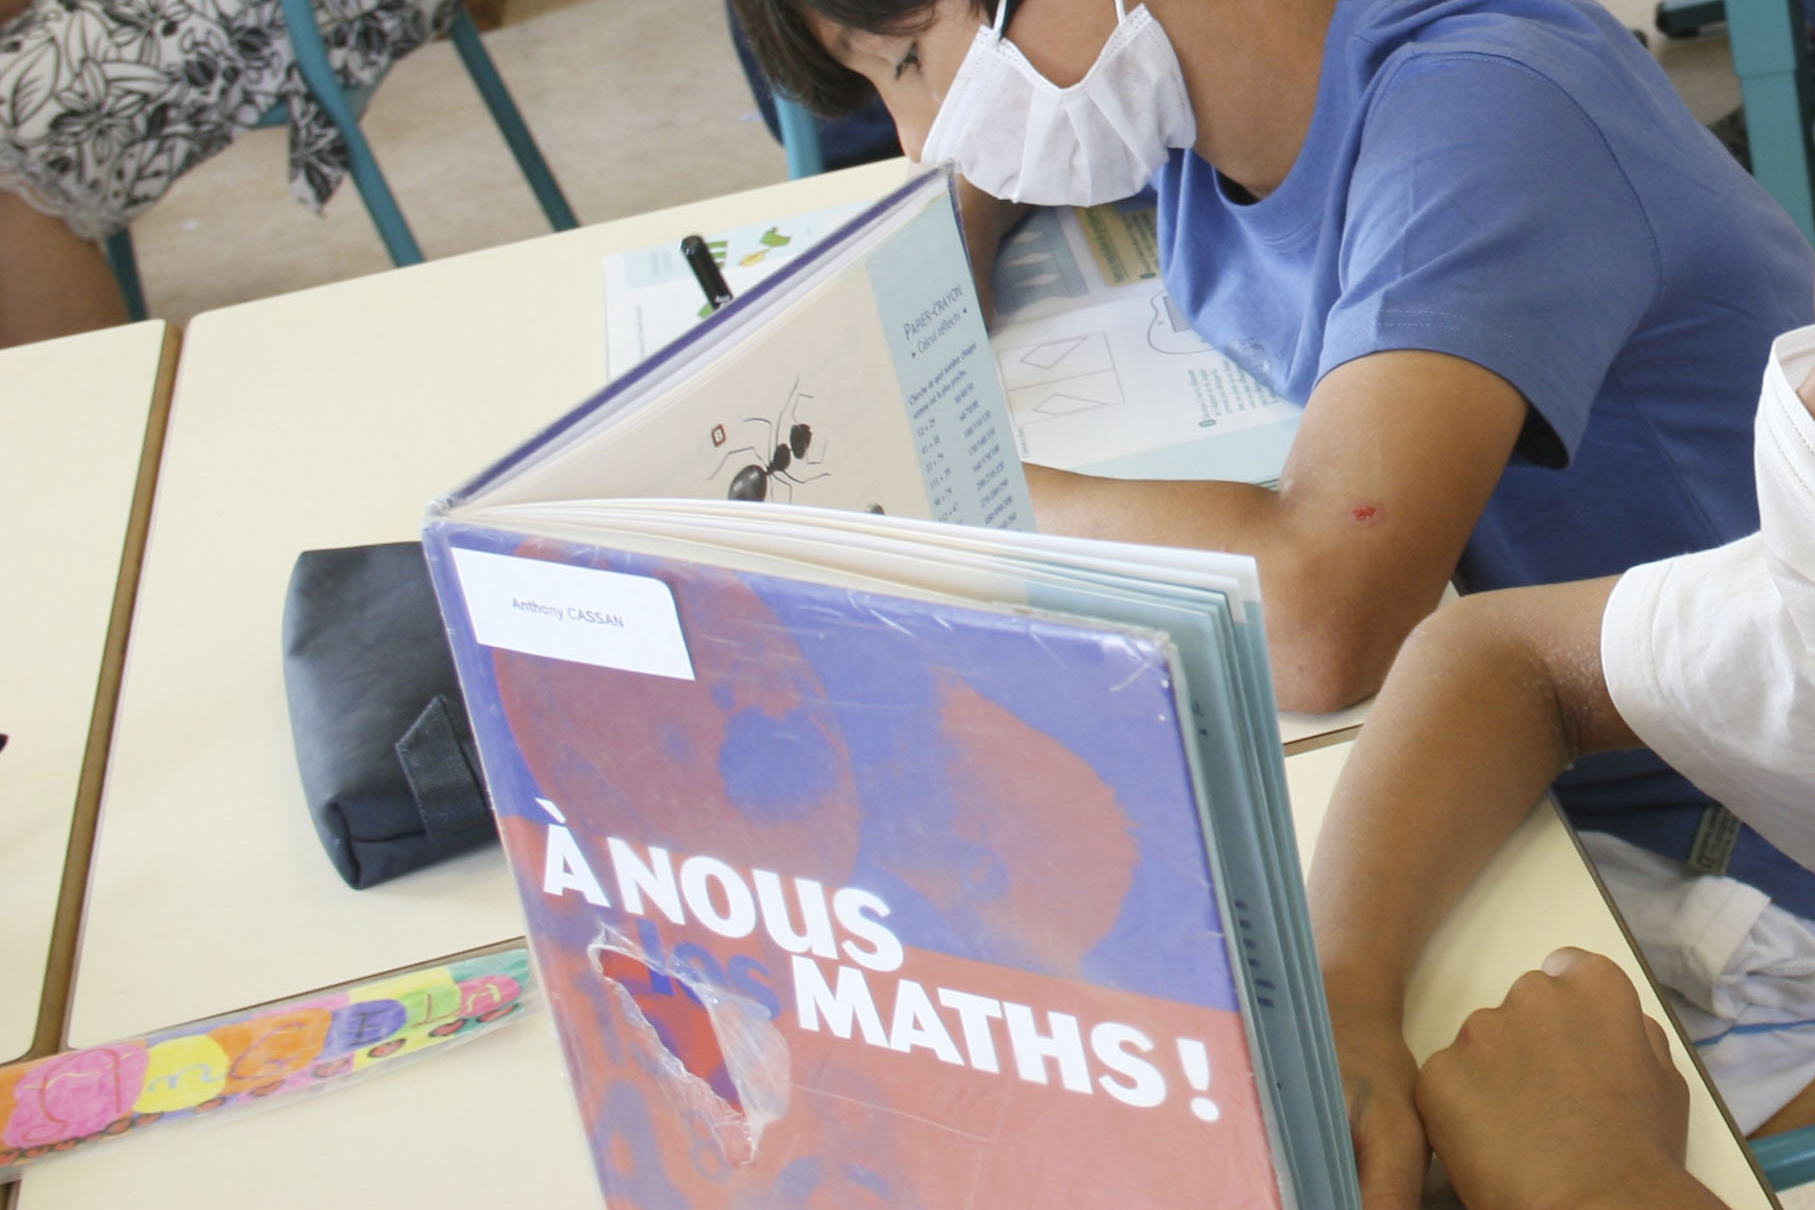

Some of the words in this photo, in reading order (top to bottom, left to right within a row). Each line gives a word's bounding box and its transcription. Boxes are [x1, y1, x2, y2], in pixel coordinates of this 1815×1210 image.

[512, 597, 563, 621] Anthony
[567, 606, 624, 628] CASSAN
[535, 797, 611, 908] À
[607, 836, 904, 973] NOUS
